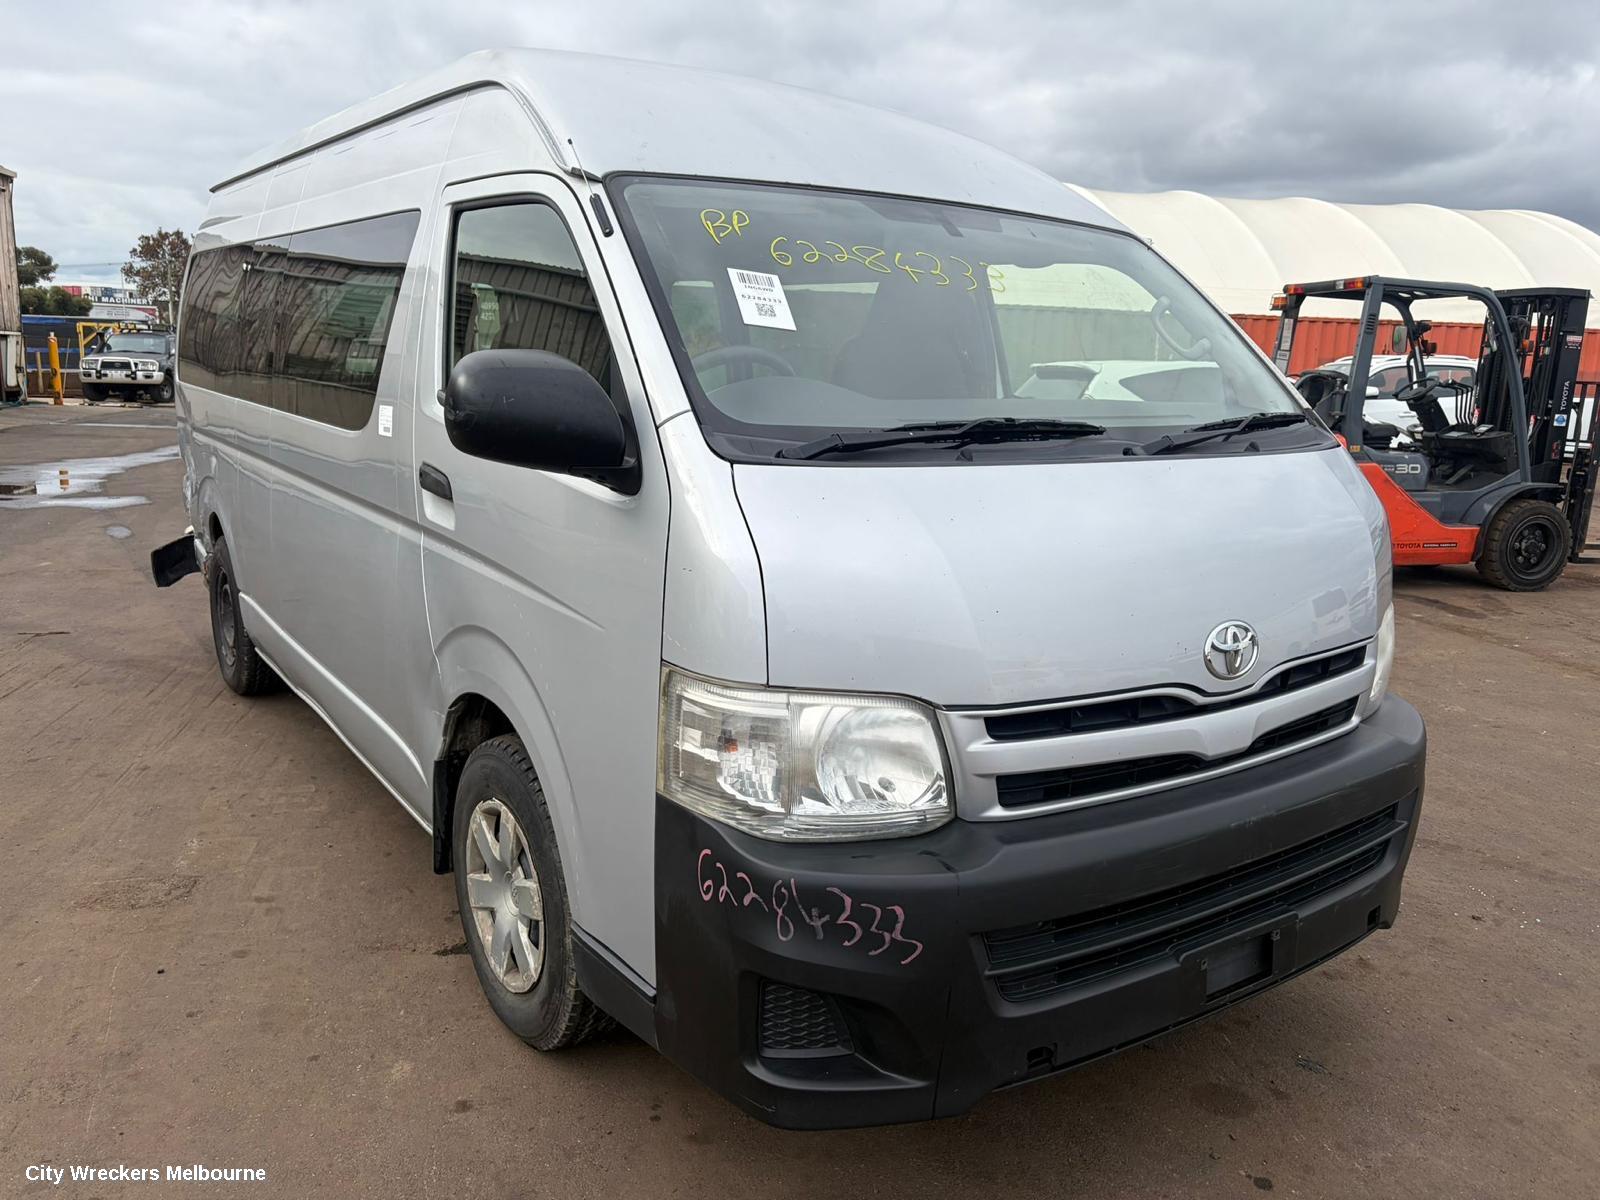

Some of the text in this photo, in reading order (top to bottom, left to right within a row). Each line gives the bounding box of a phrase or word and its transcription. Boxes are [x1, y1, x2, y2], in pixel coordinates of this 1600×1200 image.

[700, 209, 750, 245] BP
[770, 236, 1006, 293] 62284333
[101, 297, 153, 305] MACHINERY
[1560, 380, 1571, 411] TOYOTA
[1395, 464, 1421, 474] 30
[698, 848, 923, 965] 62284333
